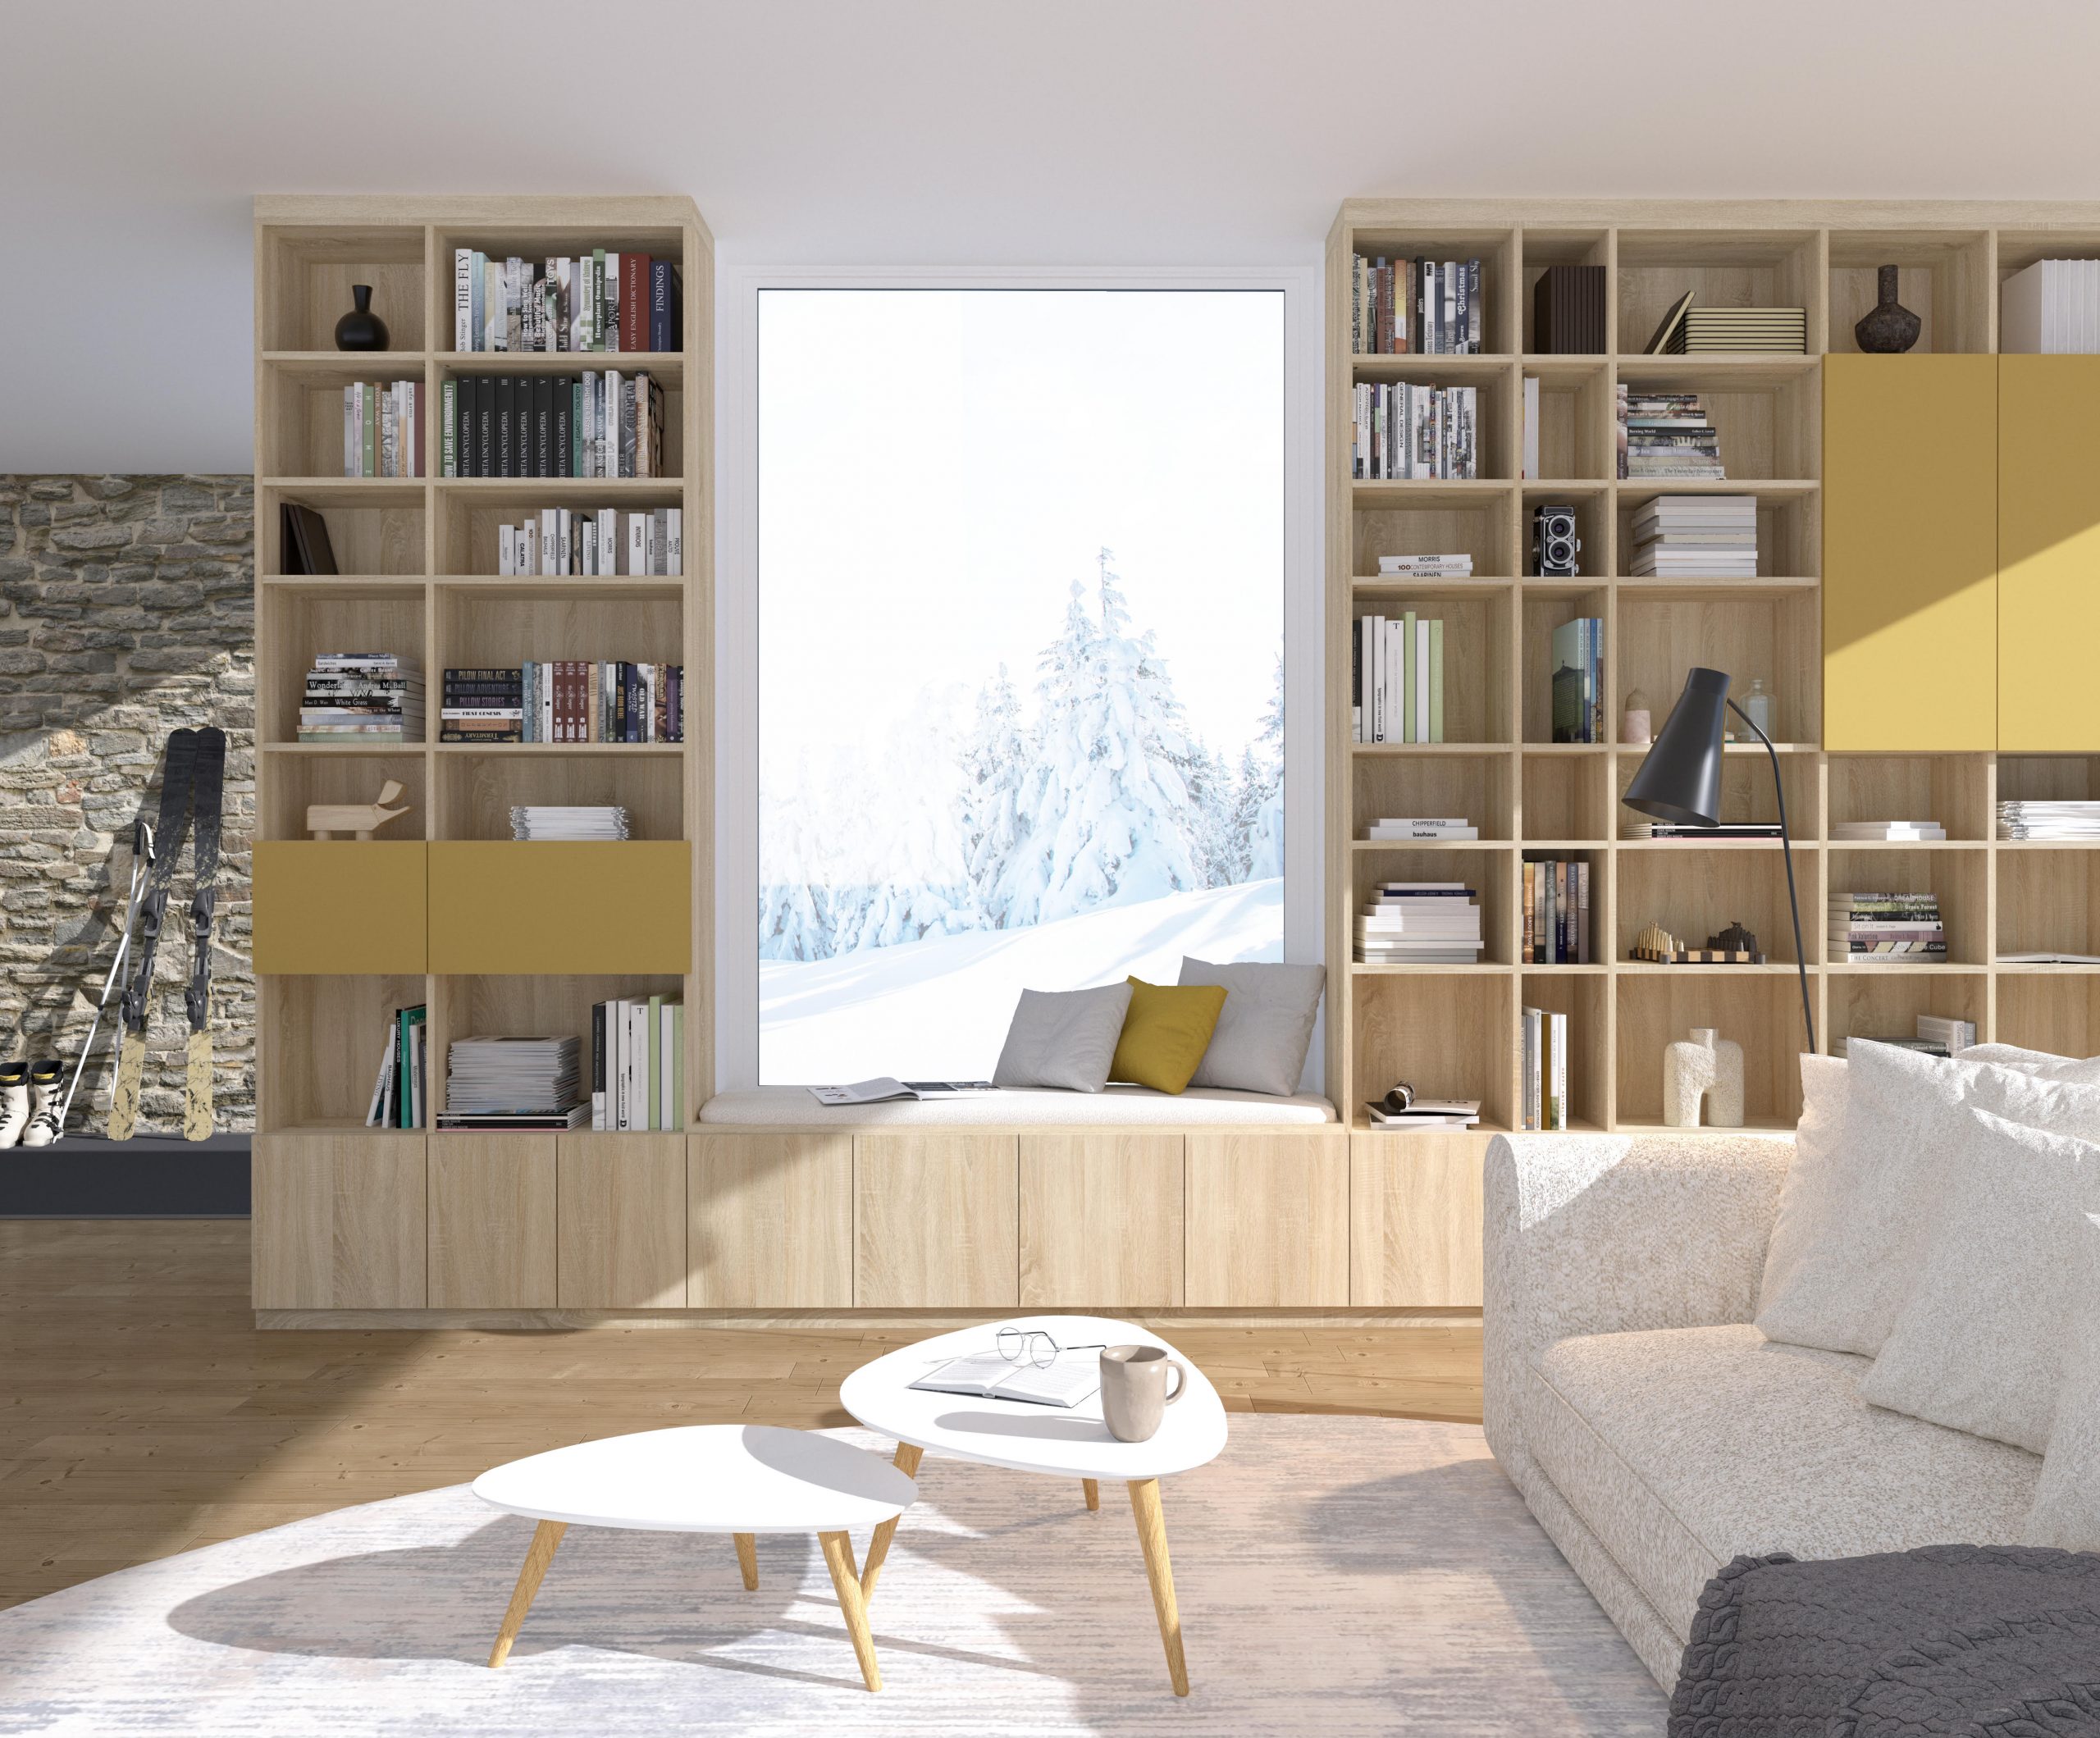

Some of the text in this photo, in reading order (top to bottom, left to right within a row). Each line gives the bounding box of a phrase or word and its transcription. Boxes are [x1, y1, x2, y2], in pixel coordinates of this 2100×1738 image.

[458, 253, 469, 312] THE FLY
[583, 285, 591, 312] Symmetry
[1458, 267, 1467, 315] Christmas
[559, 316, 568, 332] Star
[627, 384, 635, 408] METAL
[444, 437, 453, 454] SAVE
[444, 454, 453, 463] TO
[444, 464, 453, 477] HOW
[459, 670, 505, 680] PILOW FINAL ACT
[454, 684, 475, 693] PILLOW
[459, 697, 505, 707] PILLOW STORIES
[374, 1074, 384, 1096] LIVING
